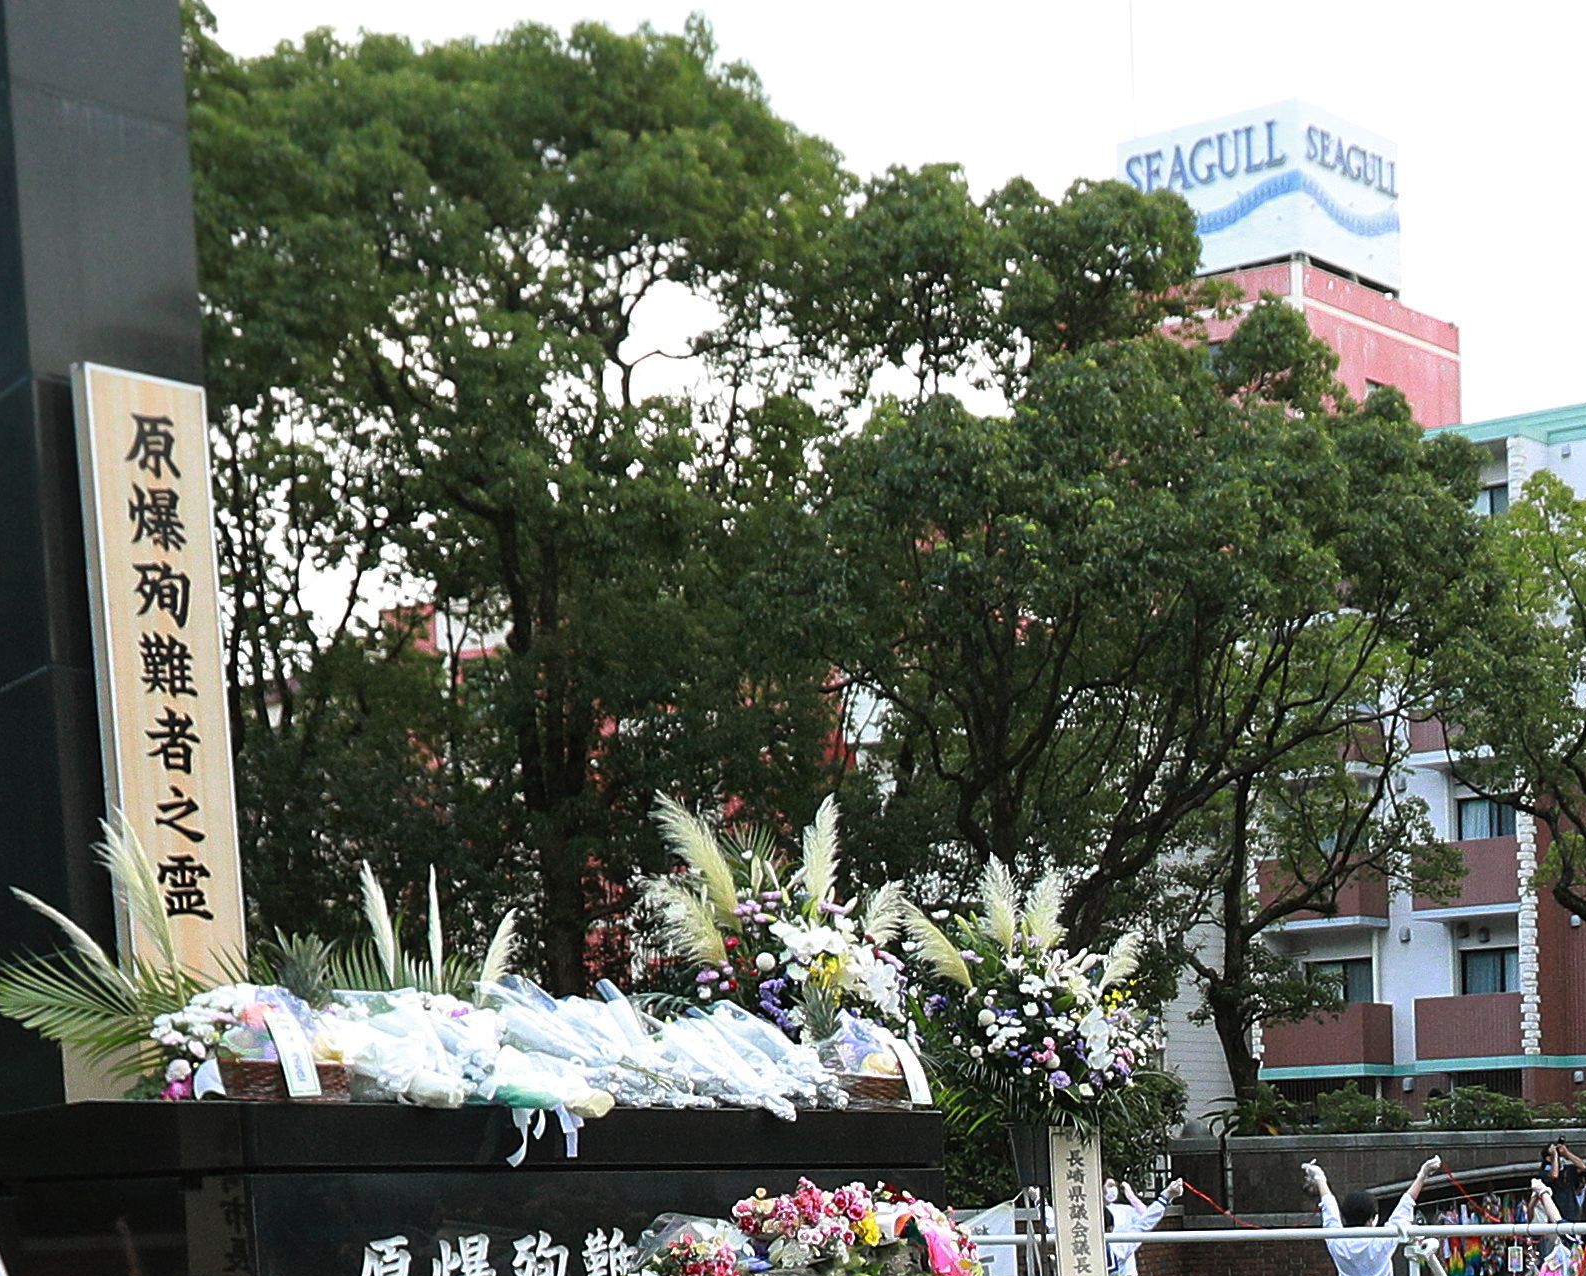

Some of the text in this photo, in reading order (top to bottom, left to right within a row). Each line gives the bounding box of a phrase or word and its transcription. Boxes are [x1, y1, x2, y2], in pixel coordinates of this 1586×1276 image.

[1125, 119, 1286, 192] SEAGULL
[1305, 125, 1399, 199] SEAGULL
[126, 413, 214, 921] 原爆殉難者之霊
[1065, 1149, 1093, 1275] 長崎県議会議長
